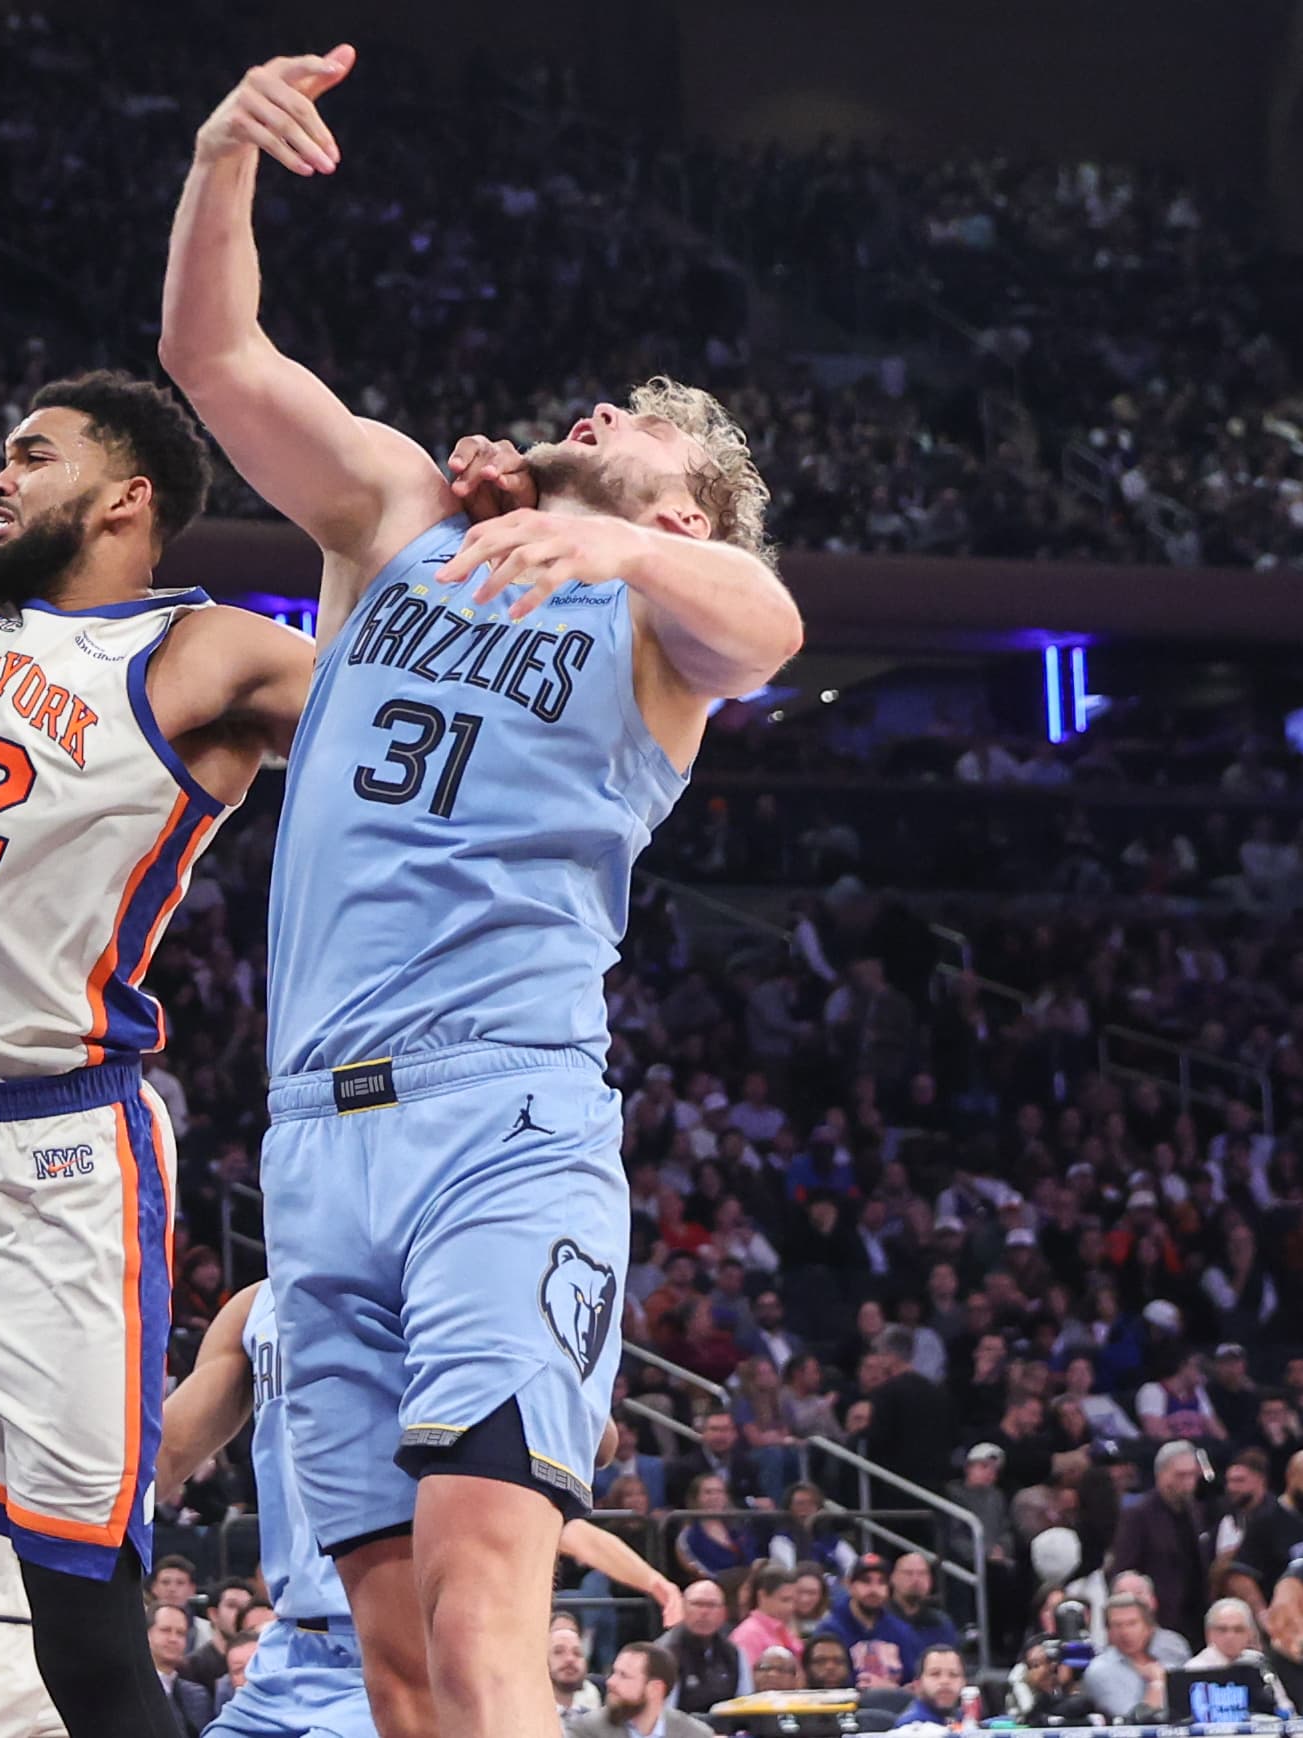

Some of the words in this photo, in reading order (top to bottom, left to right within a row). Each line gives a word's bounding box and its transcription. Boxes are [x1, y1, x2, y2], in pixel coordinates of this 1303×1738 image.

[549, 594, 613, 607] Robinhood
[348, 582, 595, 724] GRIZZLIES
[353, 698, 484, 820] 31
[33, 1144, 94, 1180] NYC
